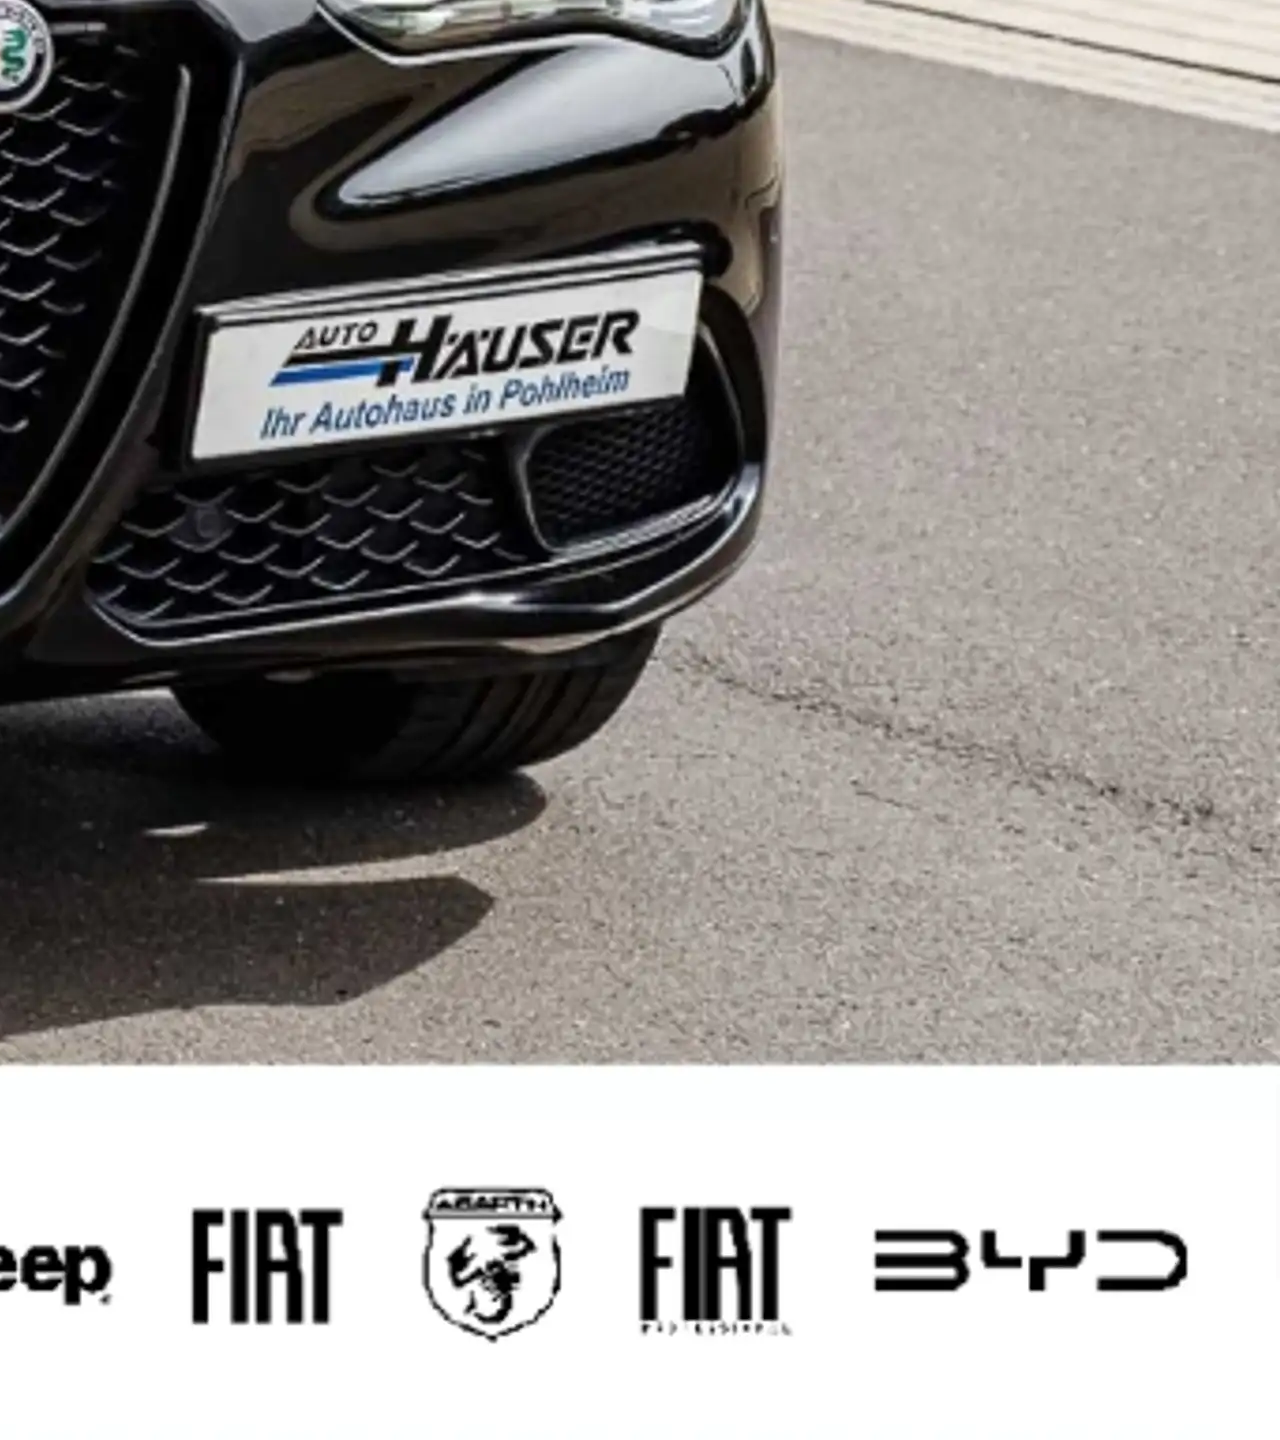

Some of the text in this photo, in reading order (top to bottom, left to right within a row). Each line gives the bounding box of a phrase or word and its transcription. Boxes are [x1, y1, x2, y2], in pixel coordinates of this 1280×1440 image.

[293, 309, 640, 388] AUTO HÄUSER
[259, 364, 631, 440] Ihr Autohaus in Pohlheim
